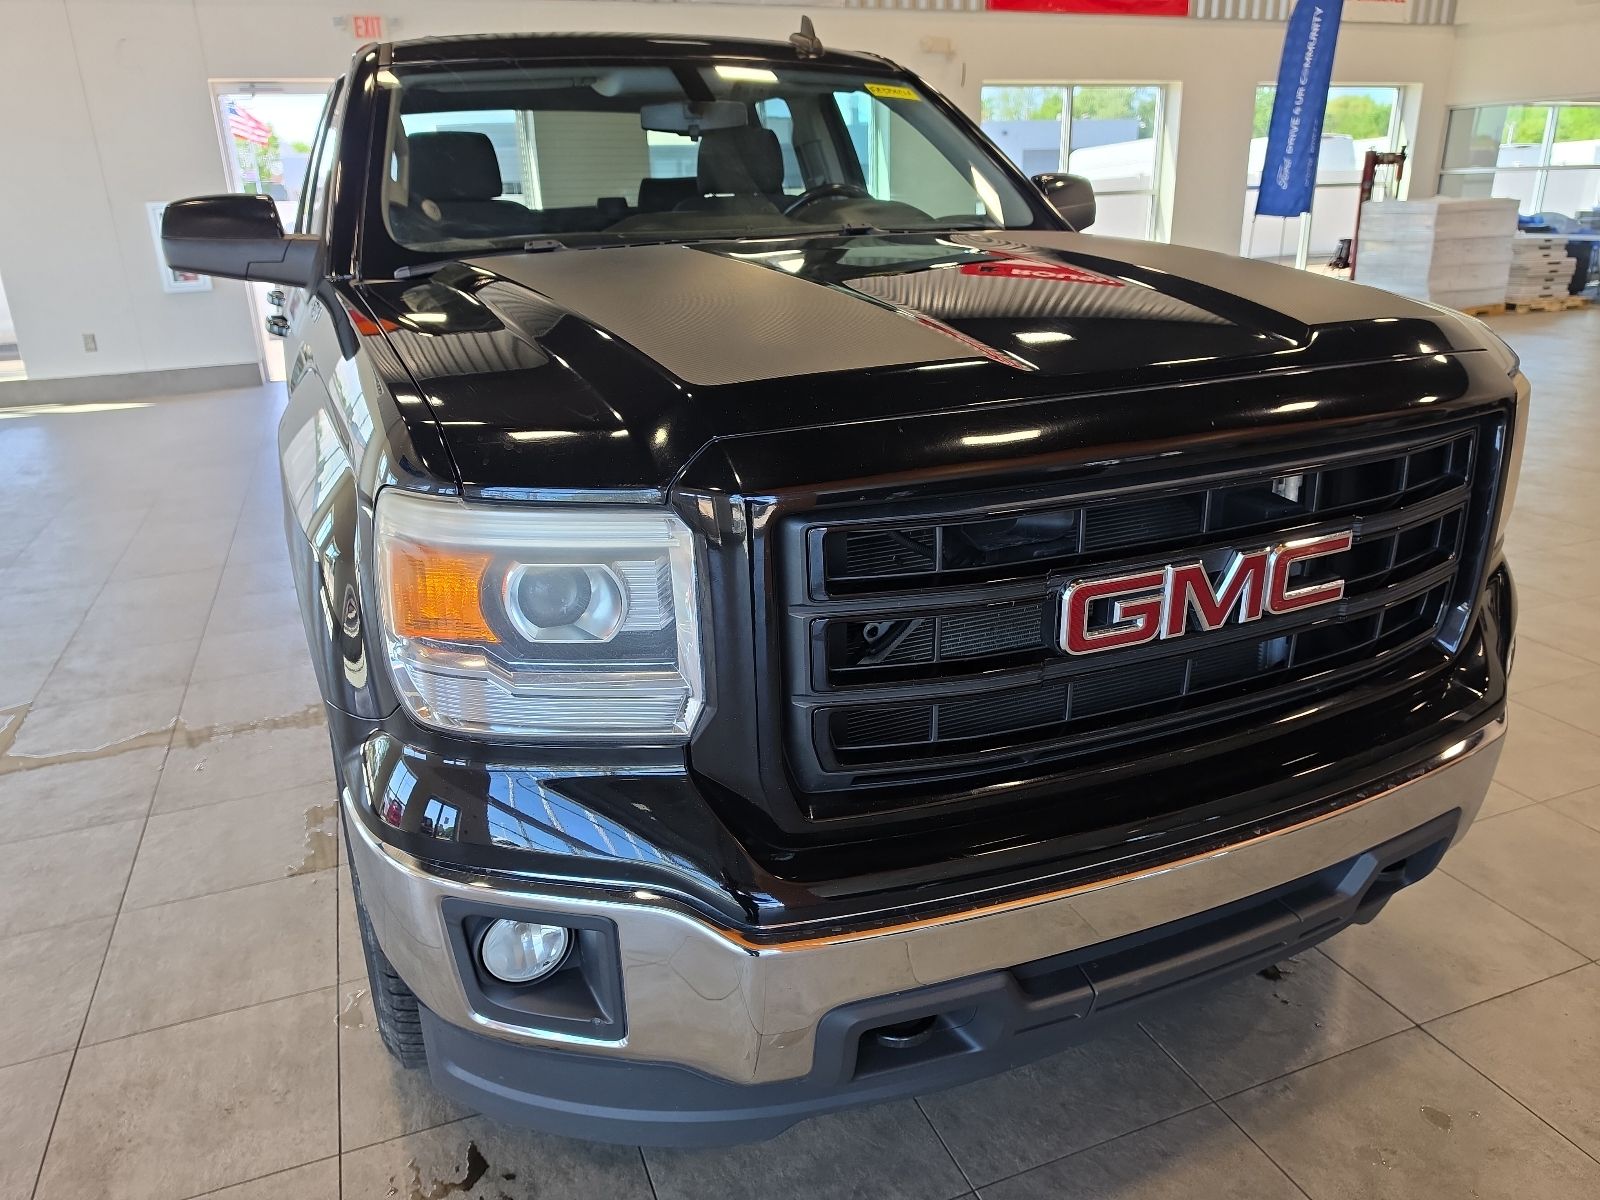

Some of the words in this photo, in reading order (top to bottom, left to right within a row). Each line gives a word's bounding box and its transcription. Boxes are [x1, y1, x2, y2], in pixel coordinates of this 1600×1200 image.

[353, 16, 381, 39] EXIT
[1286, 116, 1300, 154] DRIVE
[1295, 86, 1306, 106] UR
[1060, 530, 1353, 656] GMC
